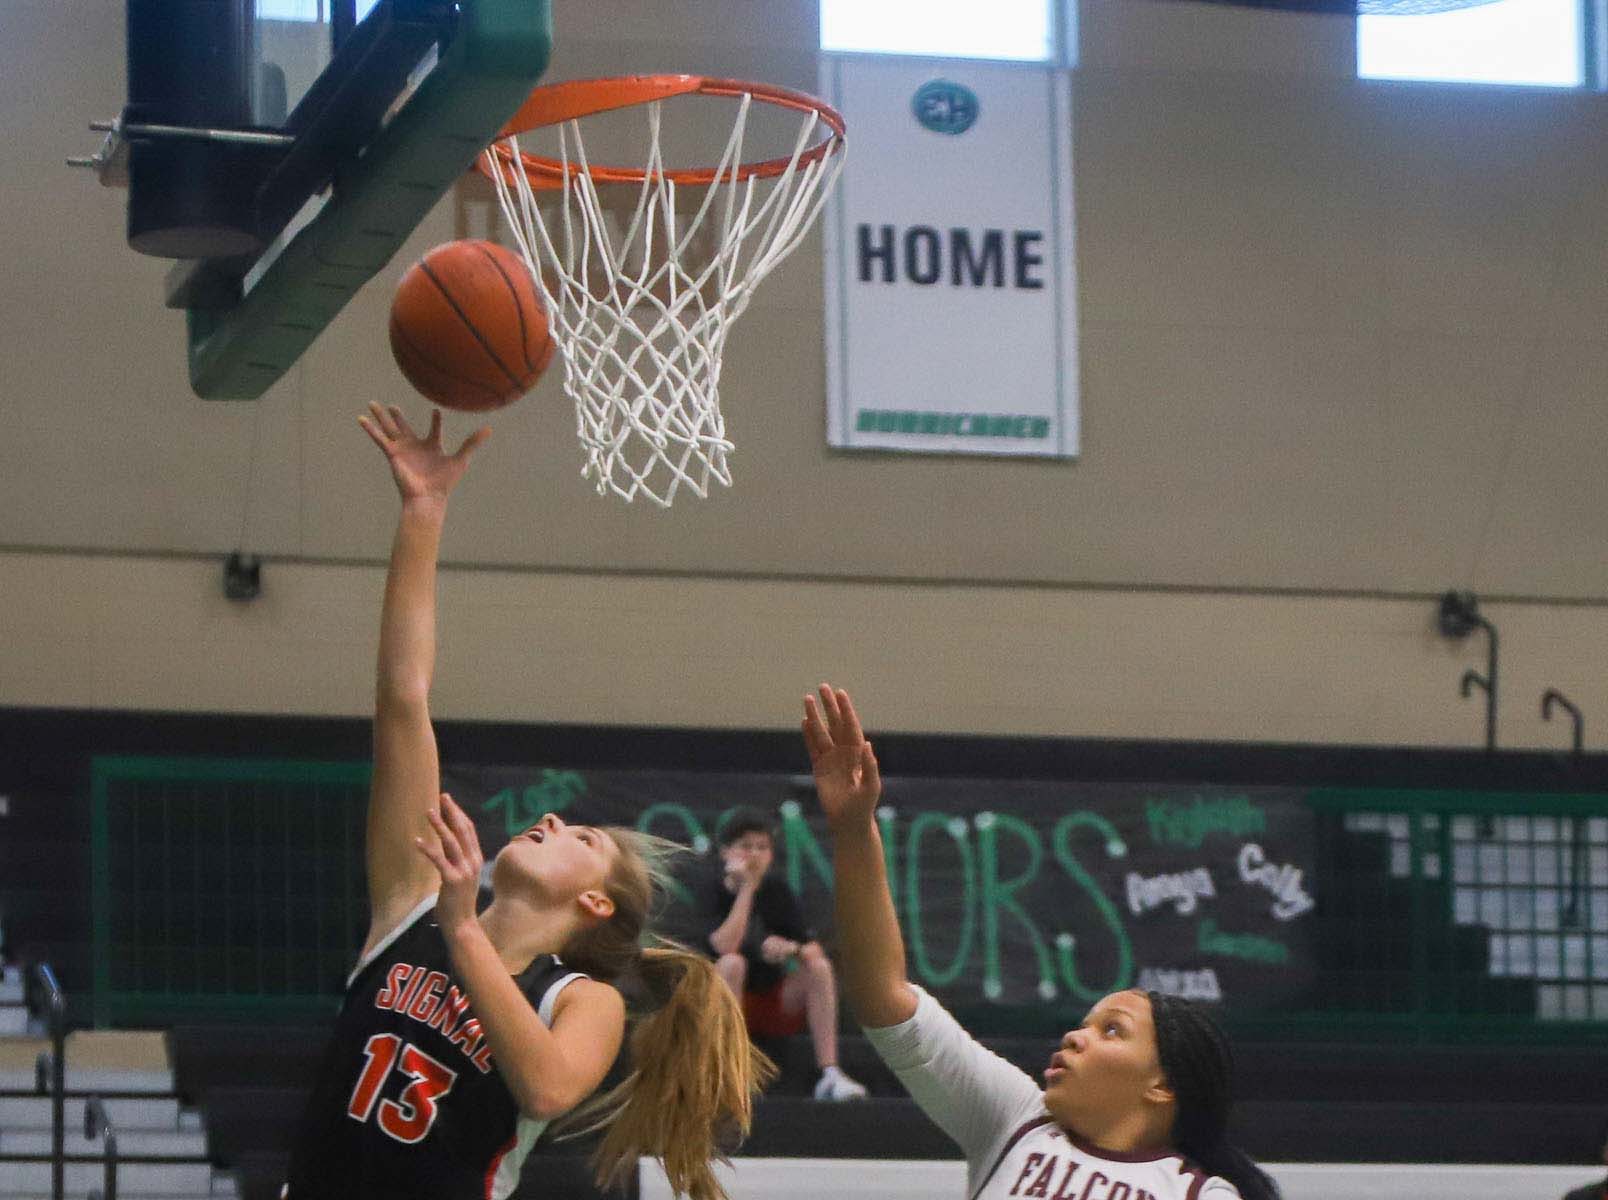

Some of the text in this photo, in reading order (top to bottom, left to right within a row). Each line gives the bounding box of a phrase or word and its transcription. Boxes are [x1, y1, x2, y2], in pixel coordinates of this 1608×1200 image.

[857, 223, 1044, 289] HOME
[375, 963, 493, 1074] SIGNAL
[348, 1033, 458, 1144] 13
